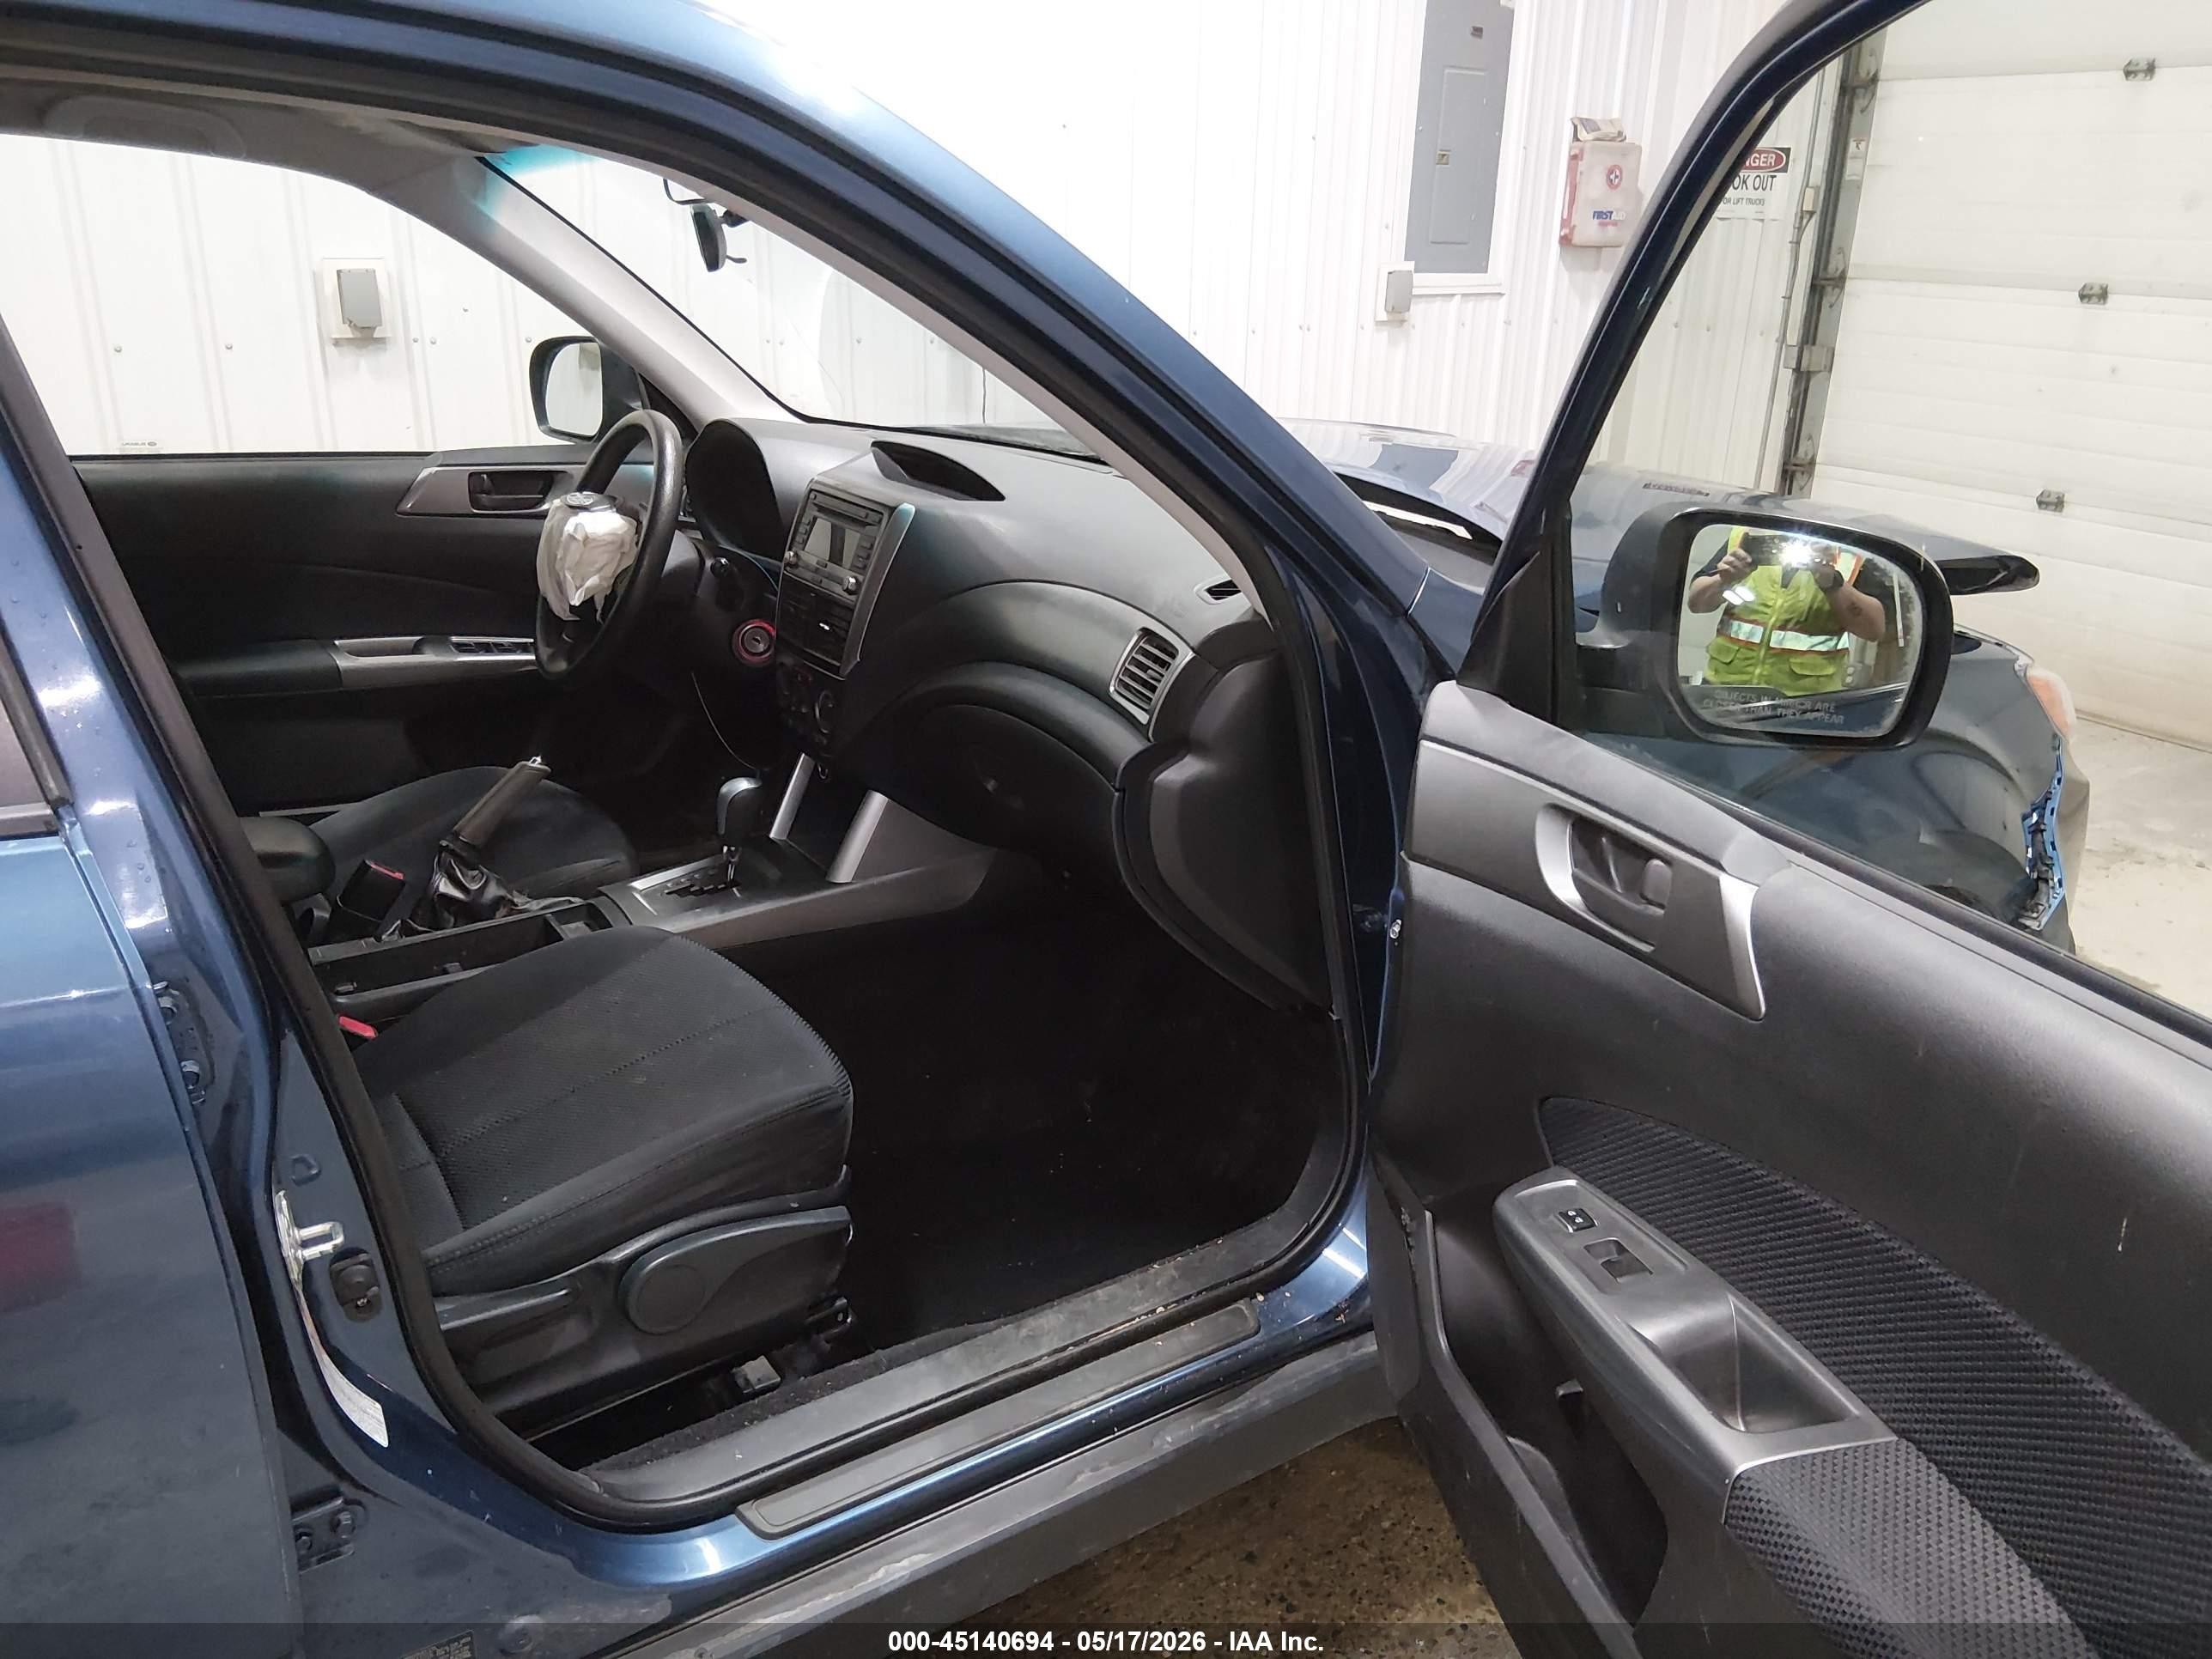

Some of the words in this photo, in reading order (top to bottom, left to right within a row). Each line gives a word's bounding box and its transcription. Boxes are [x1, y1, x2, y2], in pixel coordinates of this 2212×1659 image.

[1746, 153, 1776, 167] GER
[1733, 174, 1750, 191] OK
[1753, 174, 1777, 191] OUT
[1746, 198, 1765, 206] TRUCKS
[1814, 701, 1836, 713] ARE
